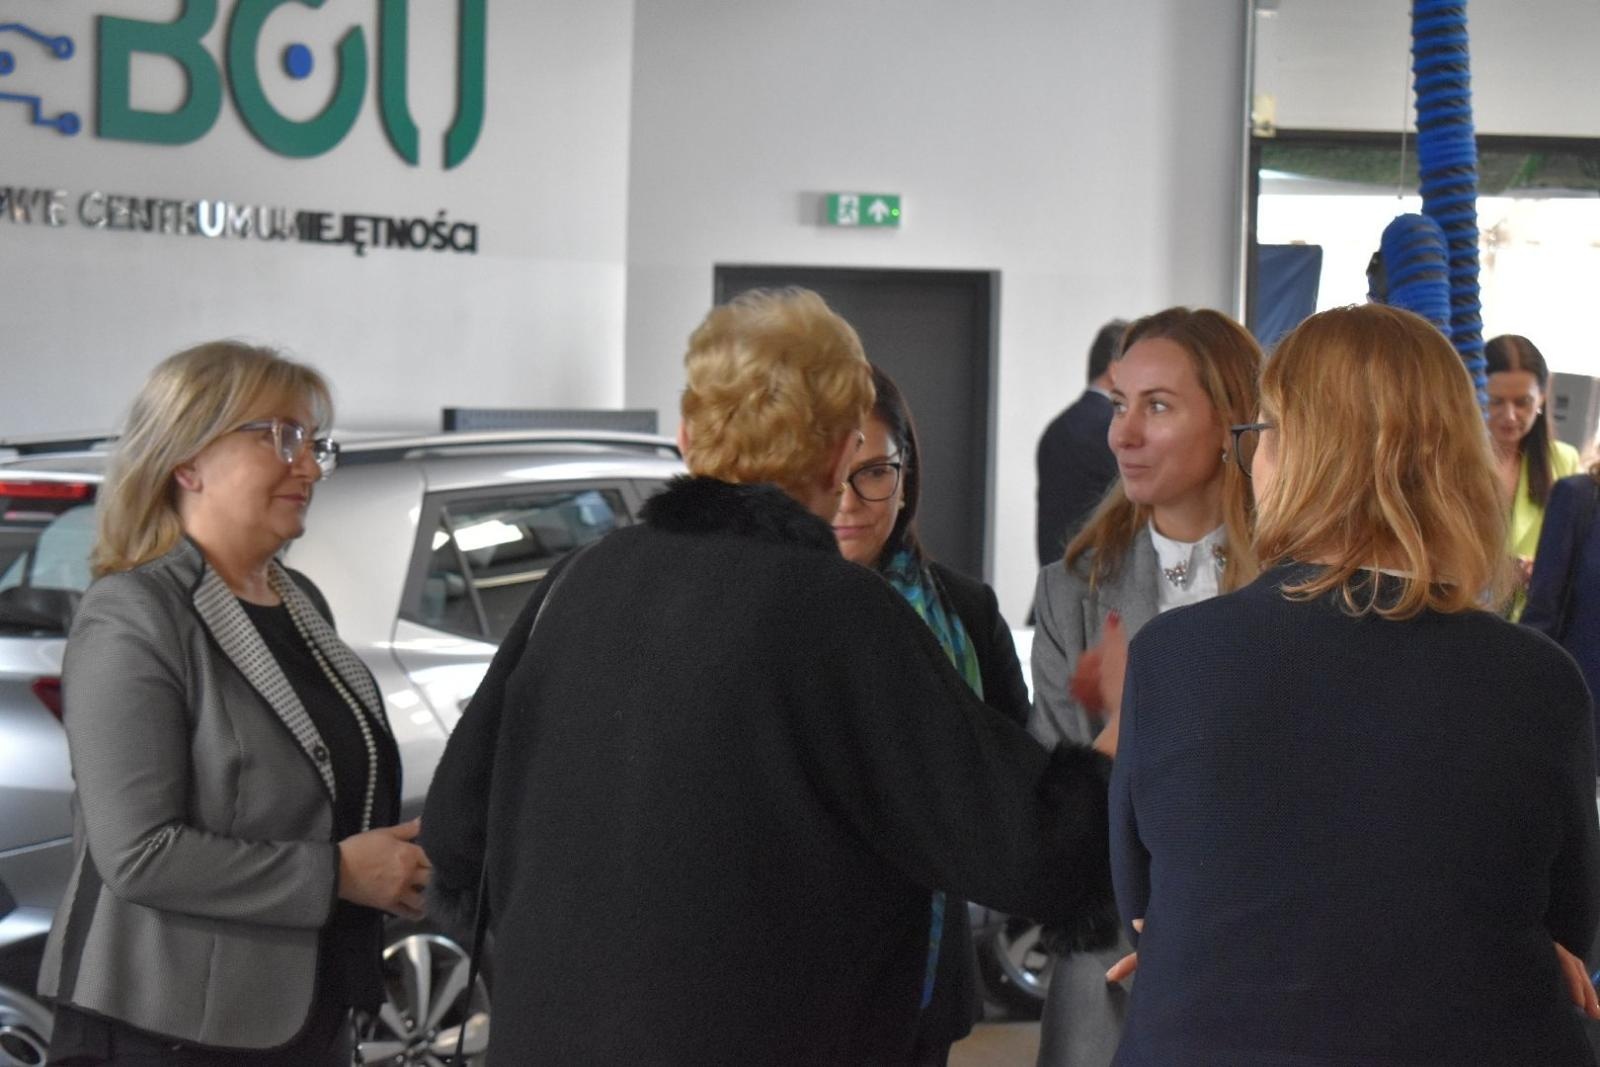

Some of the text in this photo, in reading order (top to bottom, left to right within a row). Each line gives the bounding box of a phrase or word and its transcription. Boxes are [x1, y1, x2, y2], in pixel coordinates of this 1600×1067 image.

[95, 0, 487, 170] BCU
[0, 187, 67, 227] WE
[78, 191, 251, 238] CENTRUM
